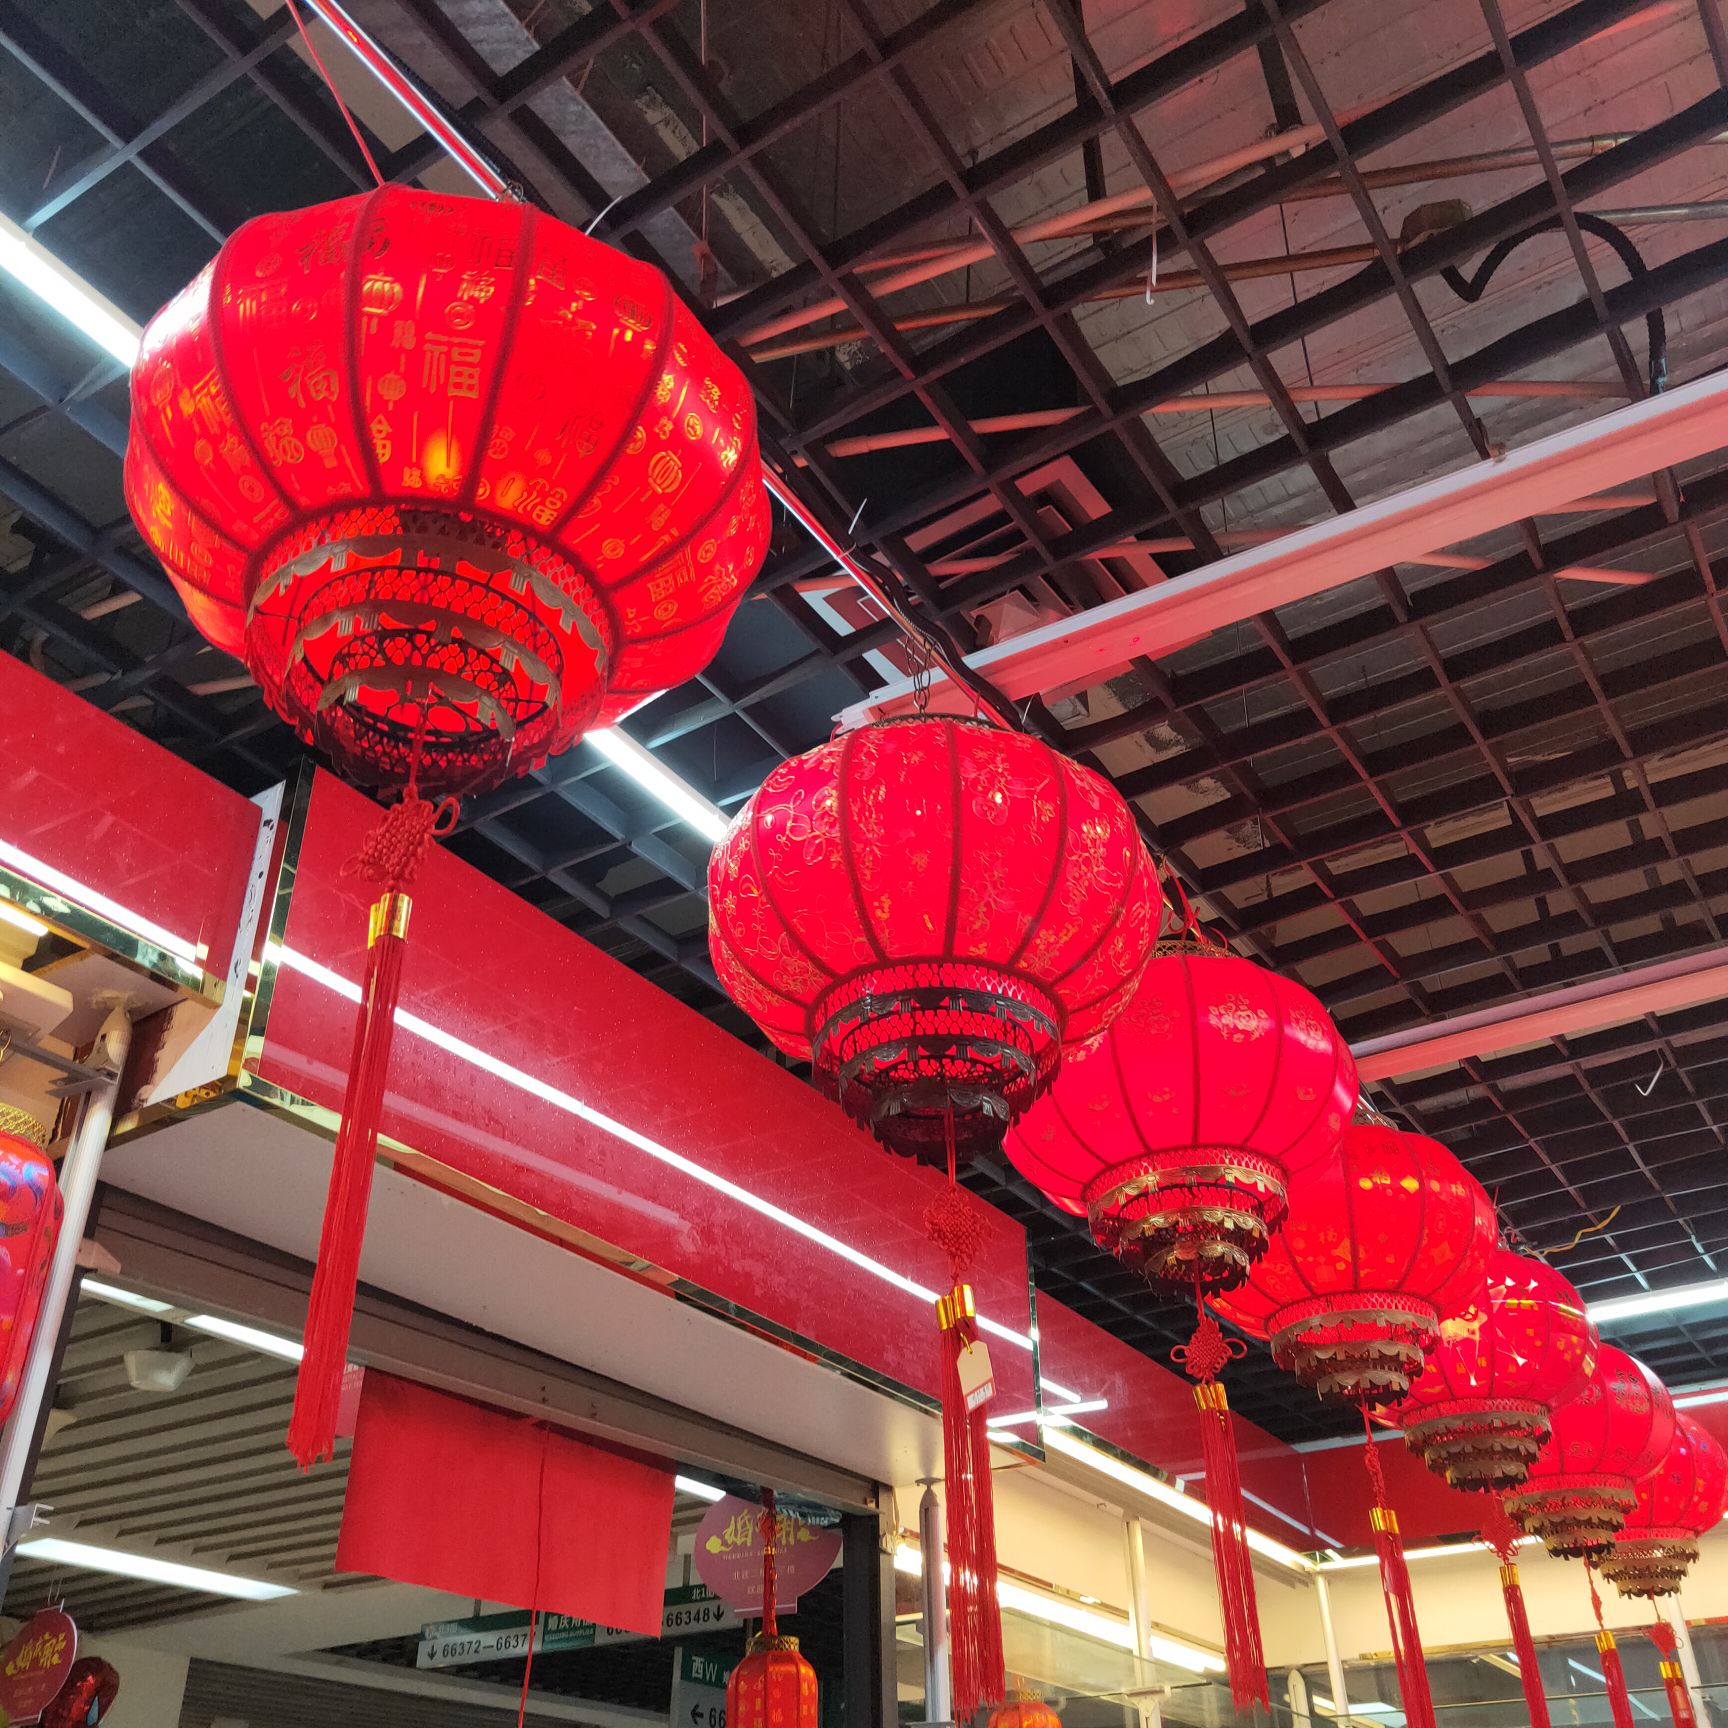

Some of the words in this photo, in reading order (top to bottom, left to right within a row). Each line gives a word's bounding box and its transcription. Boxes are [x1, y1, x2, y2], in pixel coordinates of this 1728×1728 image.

[281, 345, 339, 408] 福
[421, 331, 486, 399] 福
[666, 1607, 711, 1628] 66348
[442, 1632, 537, 1658] 66372—6637
